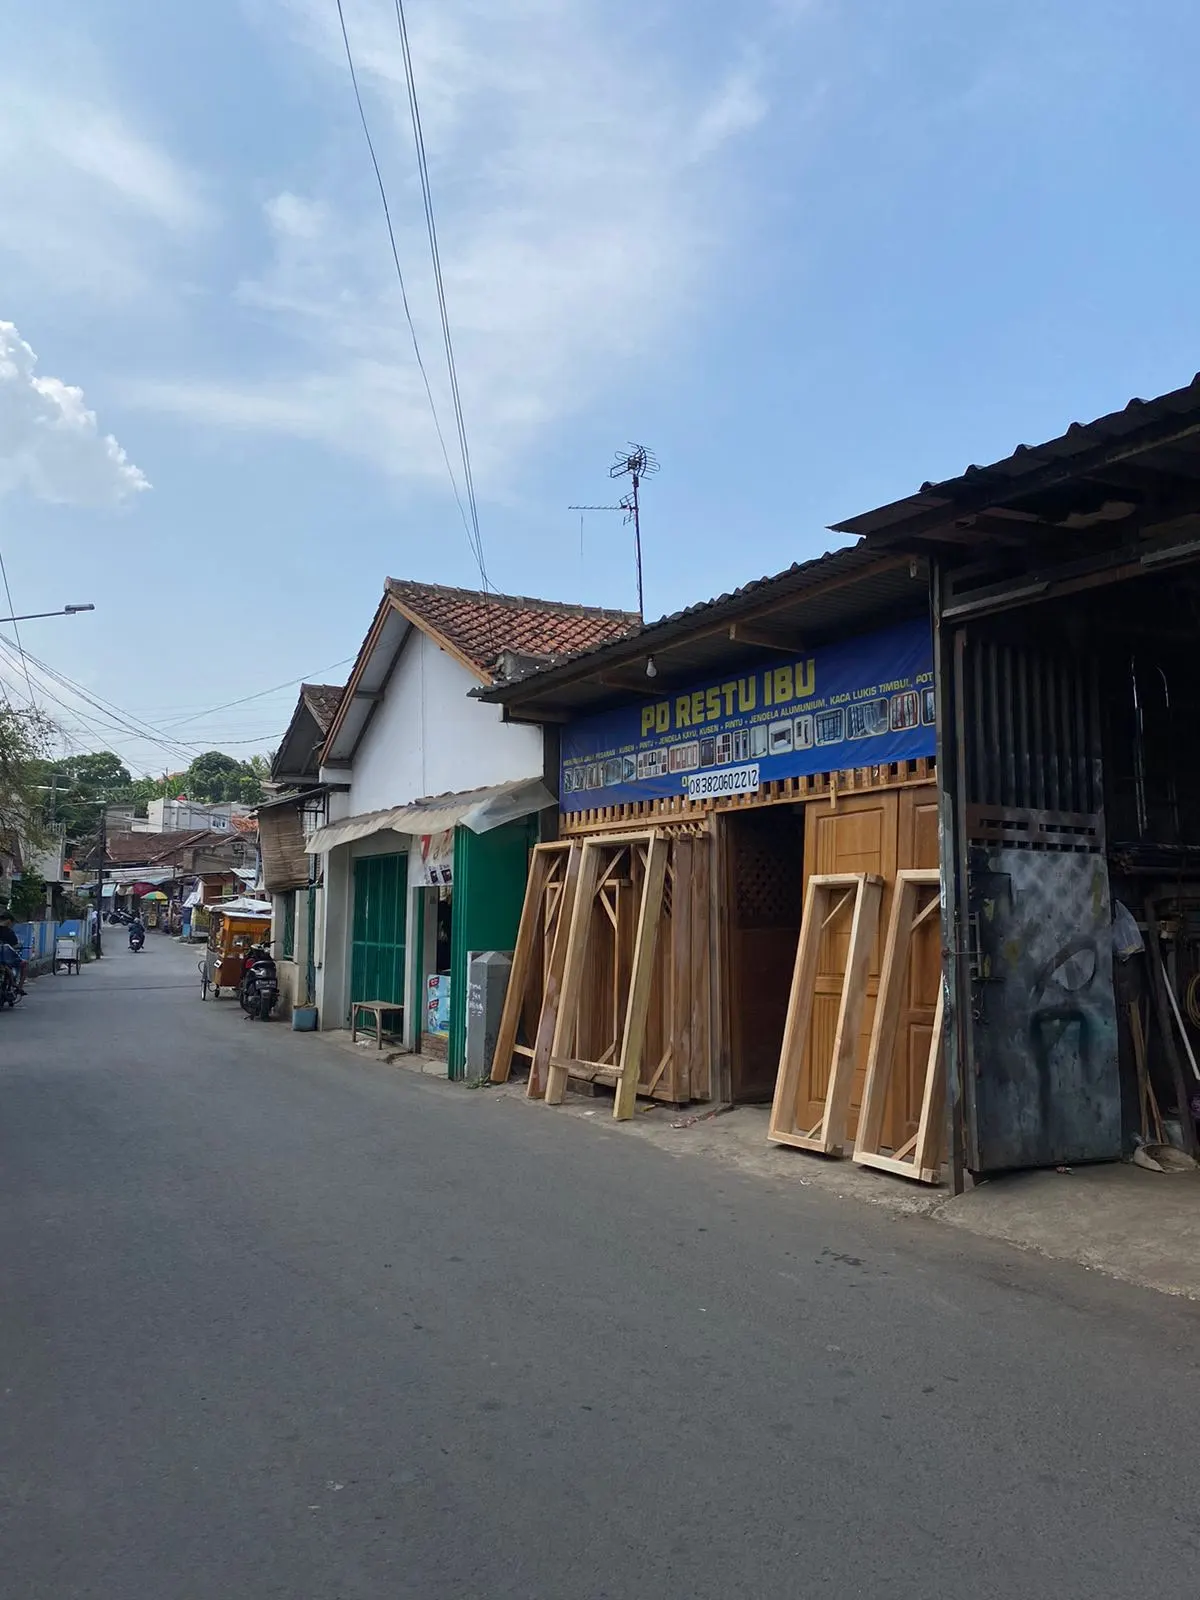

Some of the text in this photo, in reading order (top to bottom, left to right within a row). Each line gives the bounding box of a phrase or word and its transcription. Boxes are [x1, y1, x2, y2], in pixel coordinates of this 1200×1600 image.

[641, 658, 816, 736] PD RESTU IBU
[750, 709, 778, 723] JENDELA
[853, 686, 877, 700] LUKIS
[689, 769, 758, 795] 083820602212
